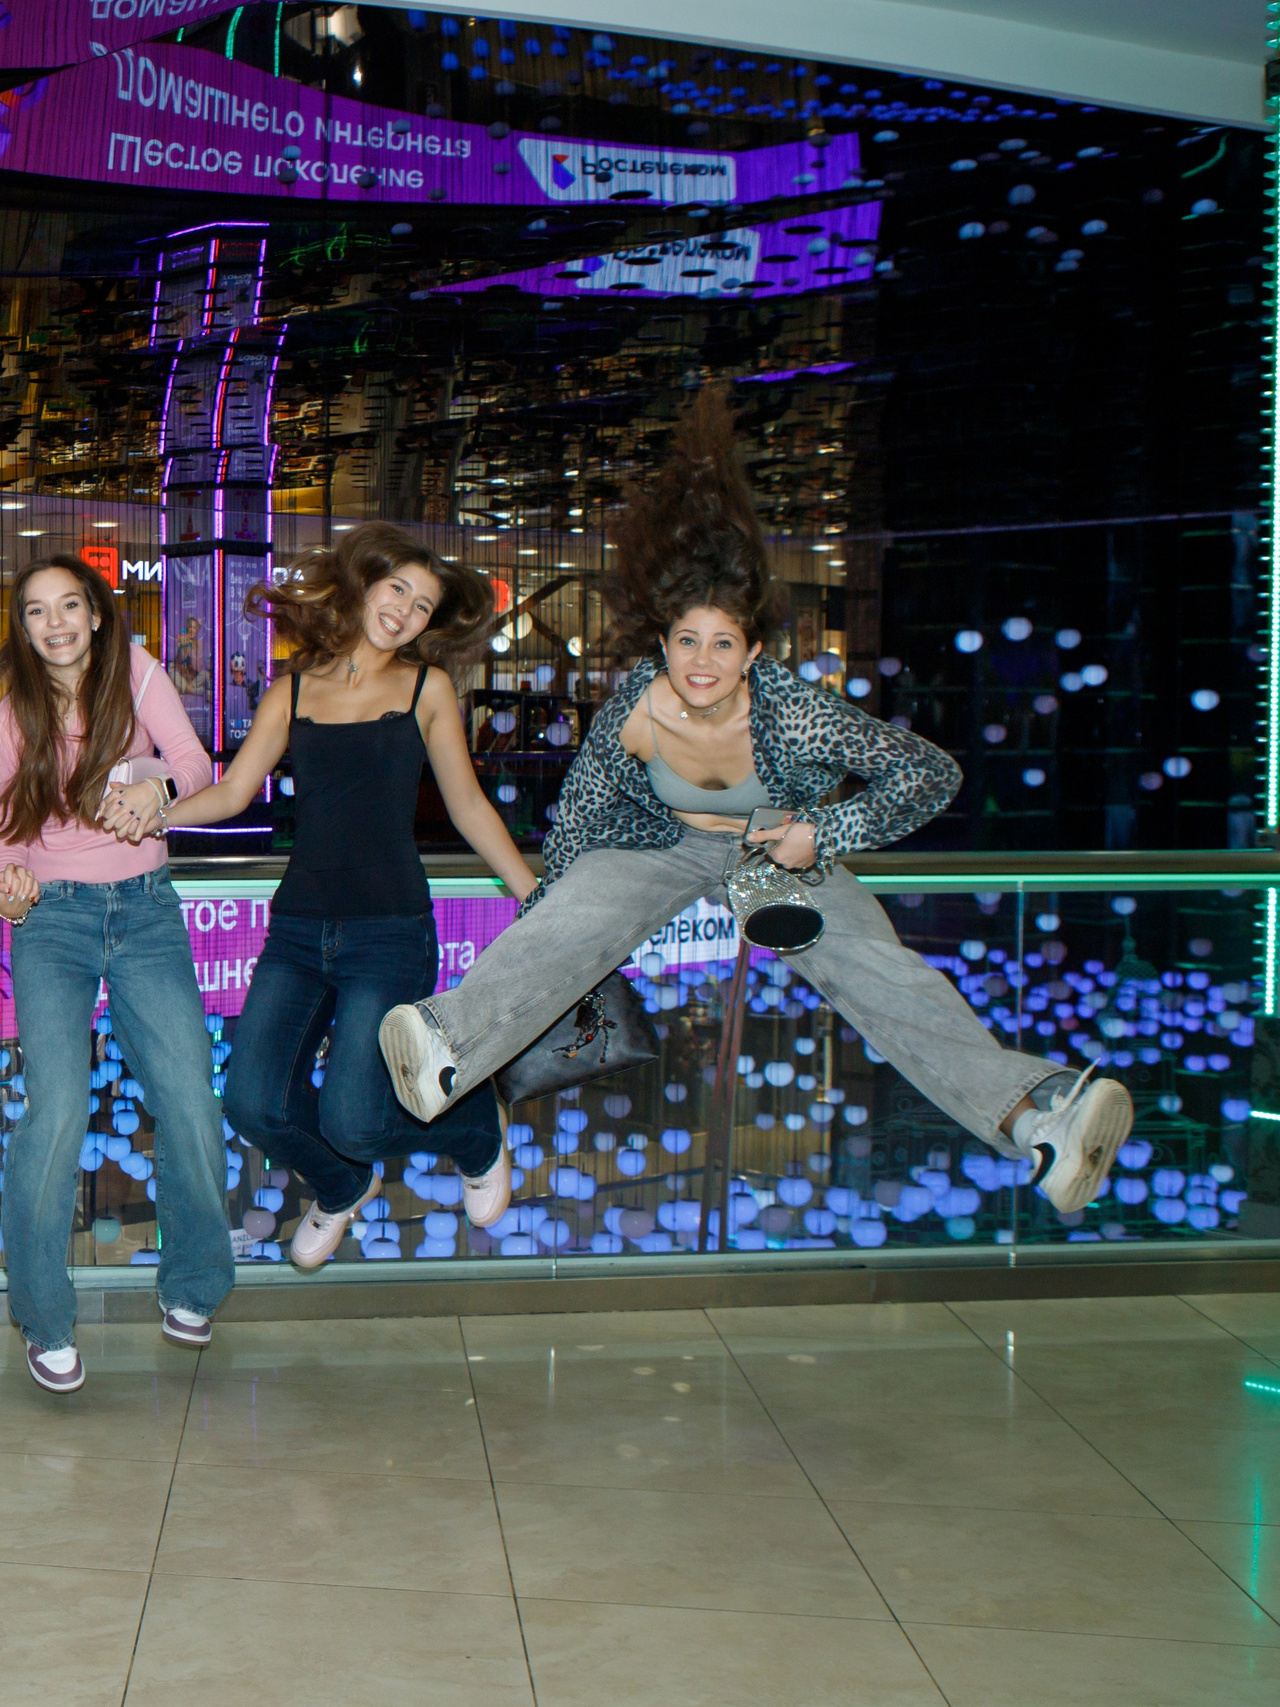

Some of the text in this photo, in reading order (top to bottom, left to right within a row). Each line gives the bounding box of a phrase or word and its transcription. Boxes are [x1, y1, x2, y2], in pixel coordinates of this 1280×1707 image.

[121, 560, 162, 582] МИ
[230, 719, 252, 728] ЧТА
[230, 730, 248, 739] ГОР
[179, 899, 238, 932] тое
[649, 917, 735, 945] елеком
